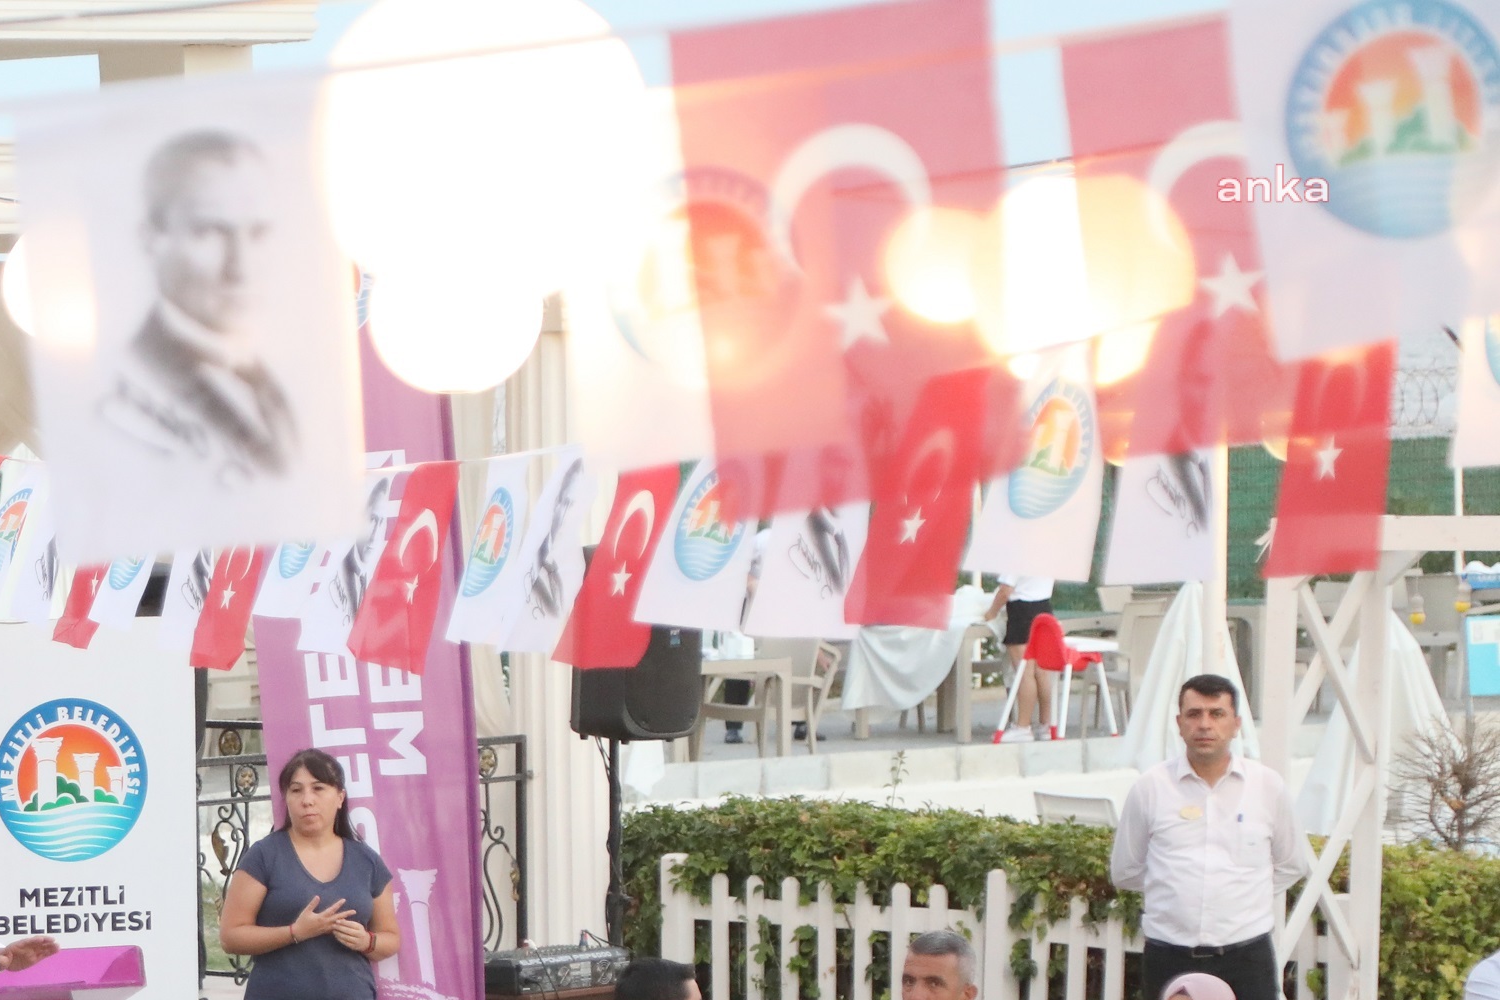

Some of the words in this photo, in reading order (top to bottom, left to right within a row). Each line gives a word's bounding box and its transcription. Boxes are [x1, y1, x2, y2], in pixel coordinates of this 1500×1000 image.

[0, 713, 47, 802] MEZİTLİ
[56, 705, 141, 796] BELEDİYESİ
[19, 885, 125, 908] MEZİTLİ
